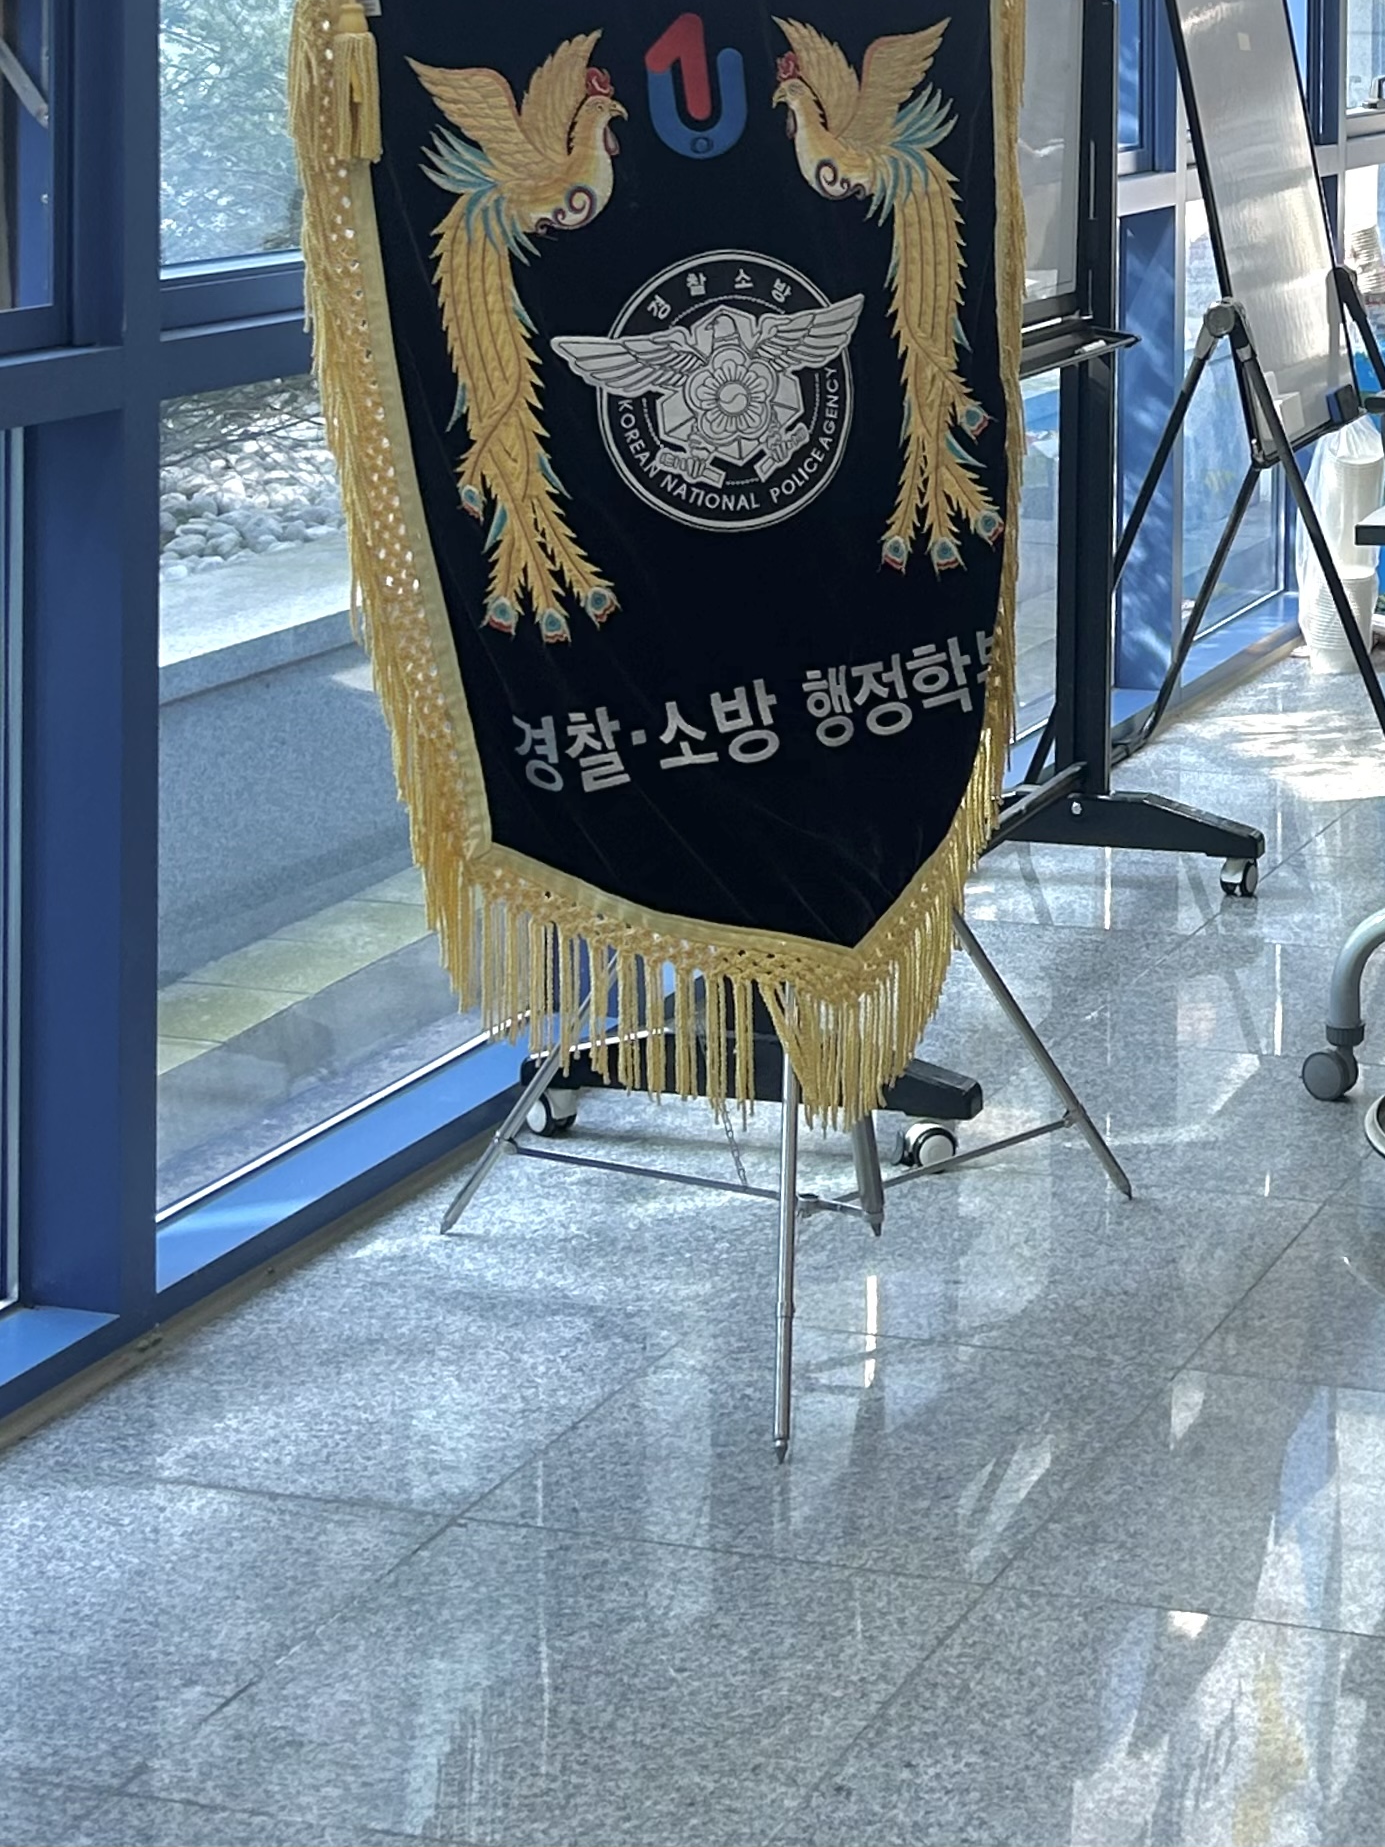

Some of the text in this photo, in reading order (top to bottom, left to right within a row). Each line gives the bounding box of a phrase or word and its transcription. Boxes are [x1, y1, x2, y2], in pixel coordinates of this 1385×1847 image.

[618, 366, 840, 512] KOREAN NATIONAL POLICE AGENCY
[512, 679, 780, 794] 경찰·소방
